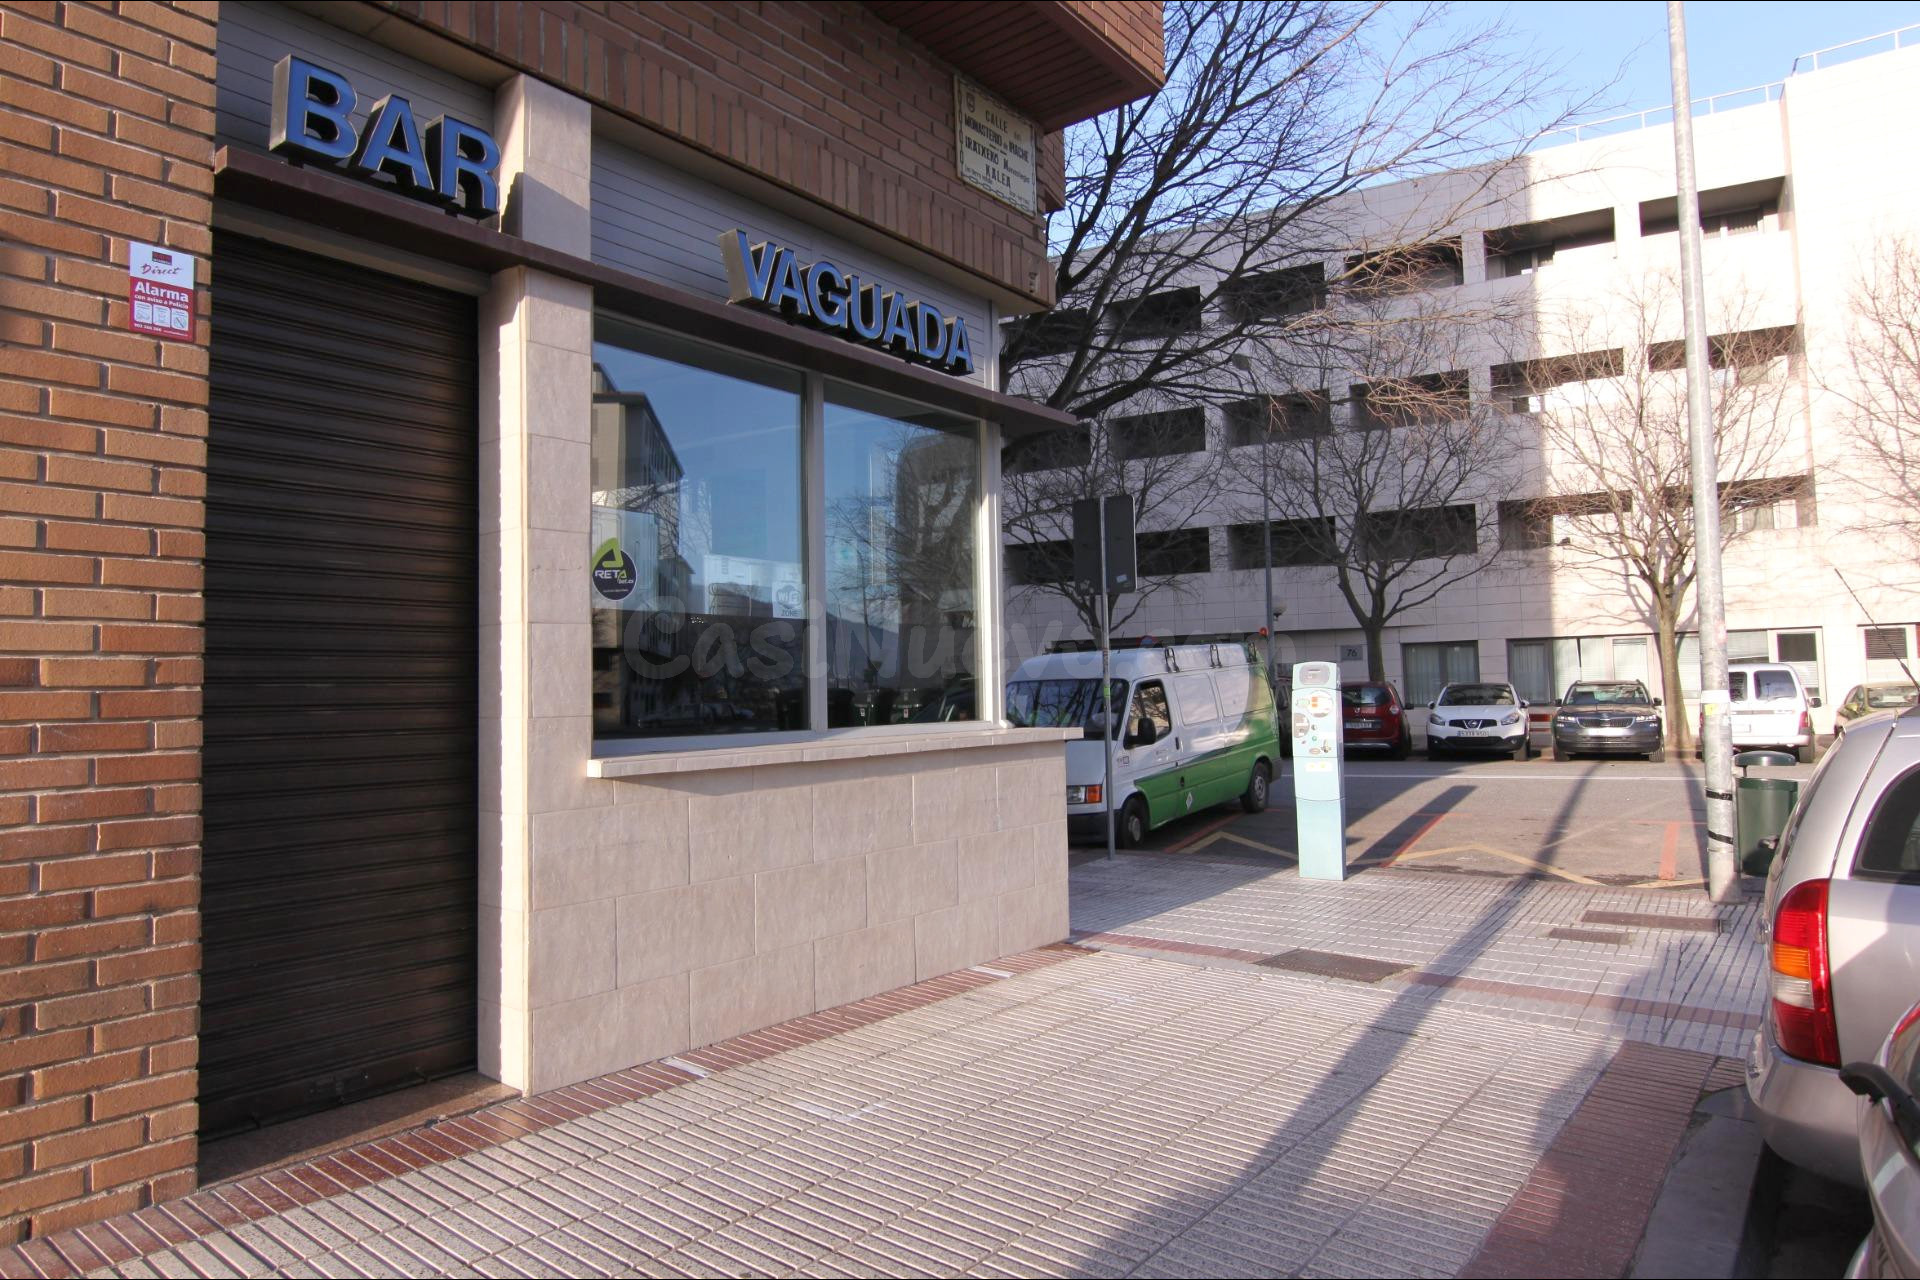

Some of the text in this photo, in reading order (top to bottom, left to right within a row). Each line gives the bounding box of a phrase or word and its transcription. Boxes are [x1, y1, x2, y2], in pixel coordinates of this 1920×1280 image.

[965, 114, 1002, 147] MONASTERIO
[985, 110, 1008, 133] CALLE
[272, 54, 502, 218] BAR
[965, 136, 999, 165] IRATXEKO
[985, 163, 1011, 189] KALEA
[140, 263, 182, 275] Direct
[134, 294, 147, 302] con
[147, 296, 163, 304] aviso
[135, 281, 189, 303] Alarma
[722, 229, 975, 376] VAGUADA
[594, 569, 627, 579] RETA
[1346, 648, 1358, 657] 76
